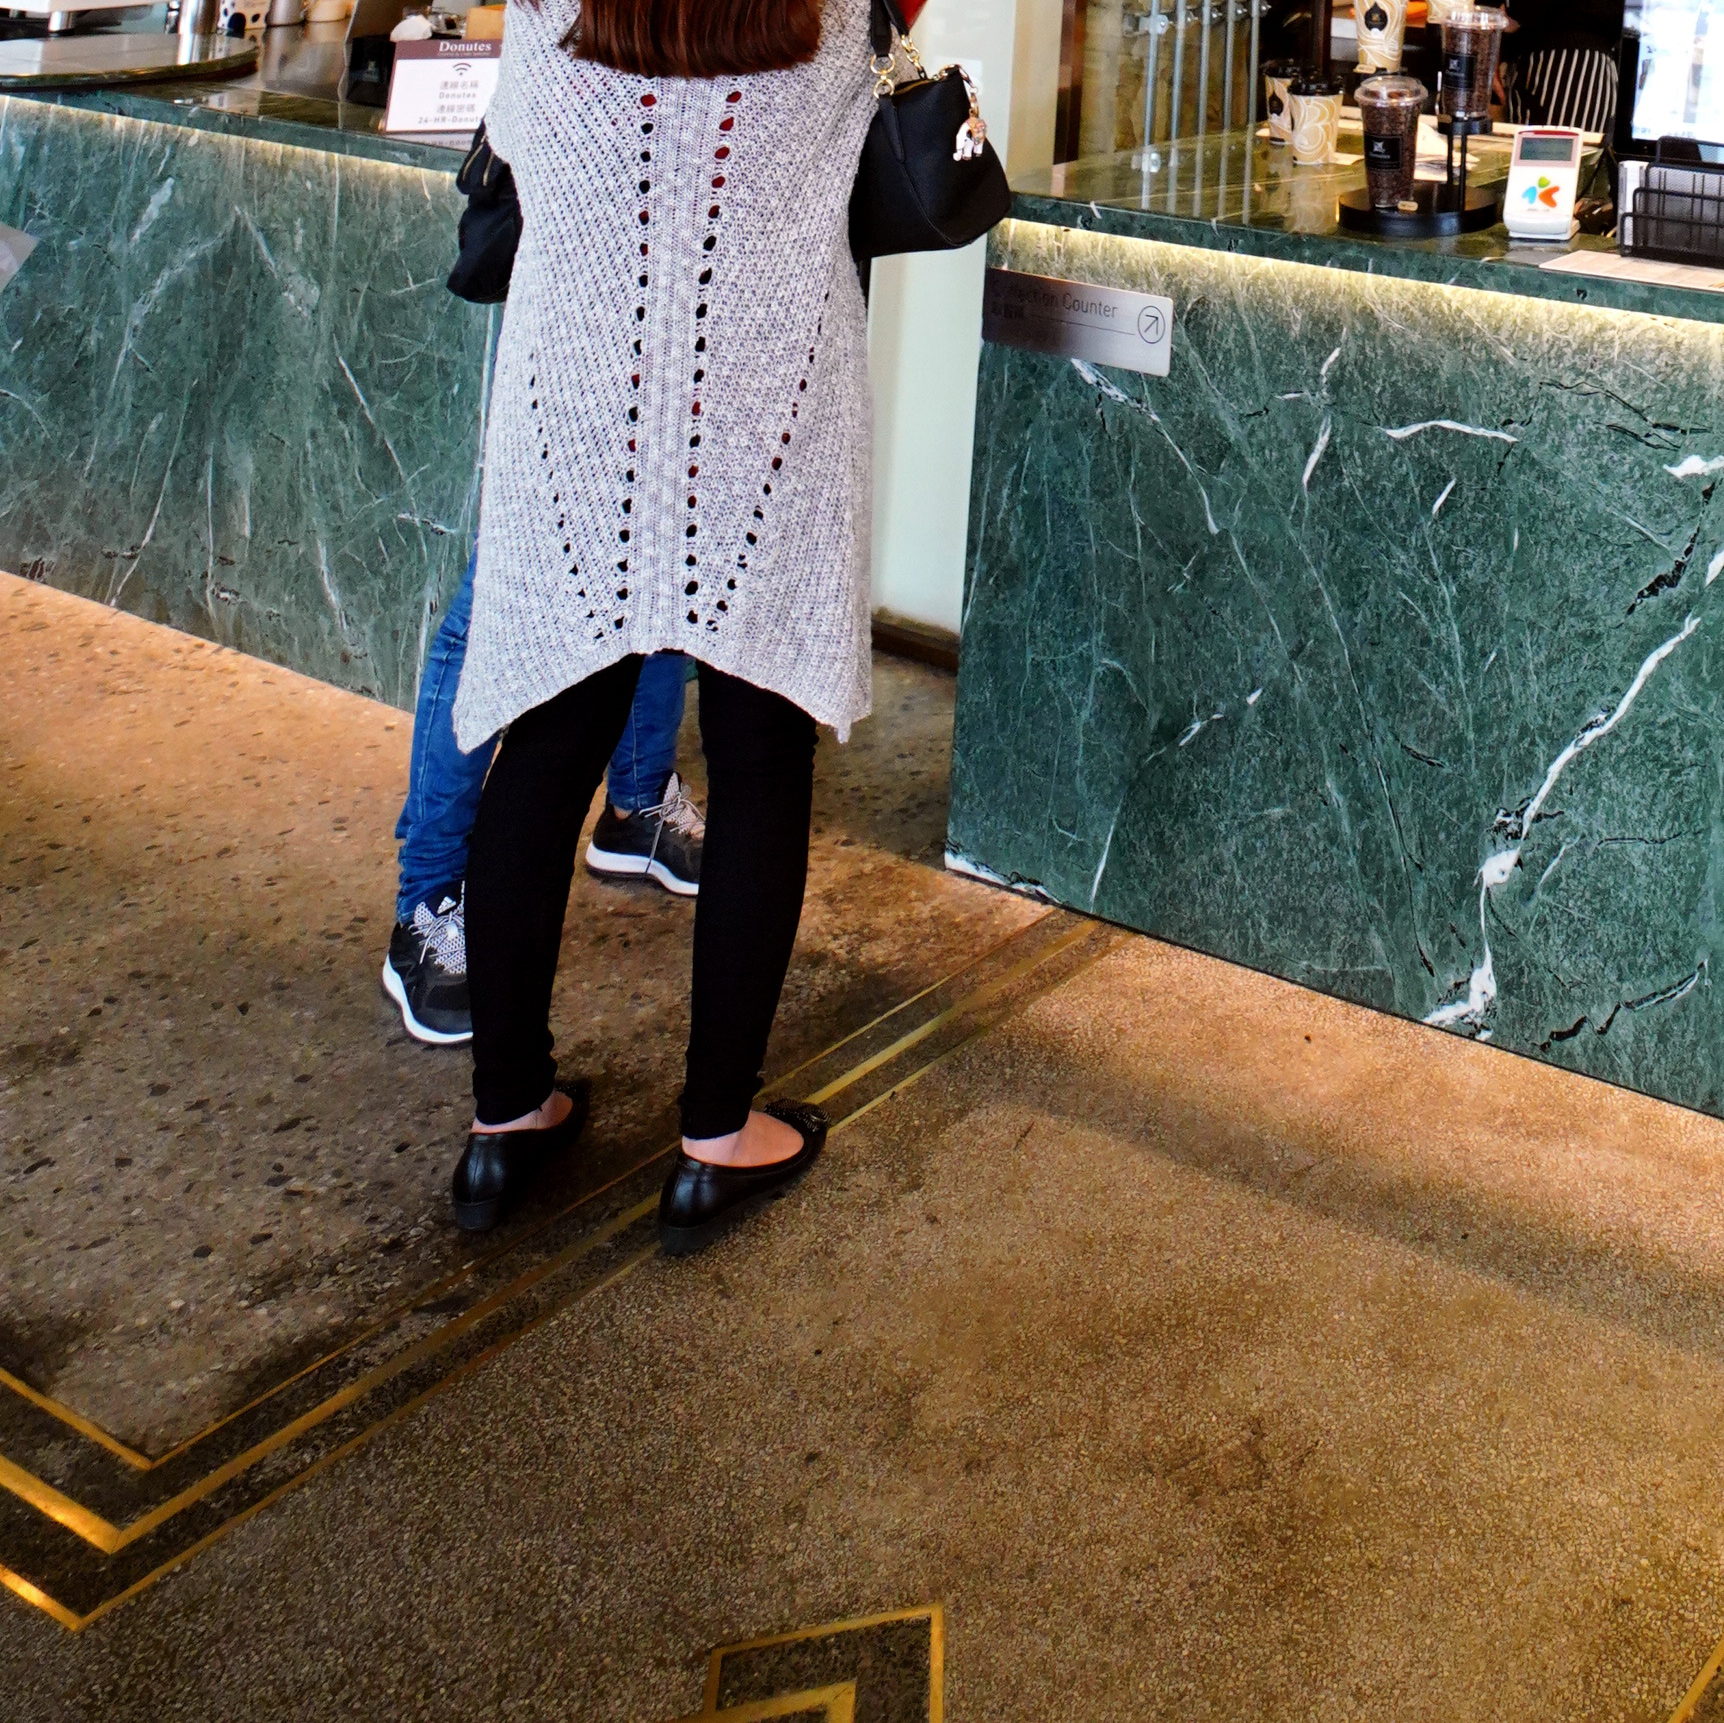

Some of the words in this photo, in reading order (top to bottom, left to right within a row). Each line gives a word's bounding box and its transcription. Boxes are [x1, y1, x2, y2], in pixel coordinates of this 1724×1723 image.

[439, 41, 492, 52] Donutes
[439, 91, 476, 99] Donutes
[1062, 292, 1119, 318] Counter
